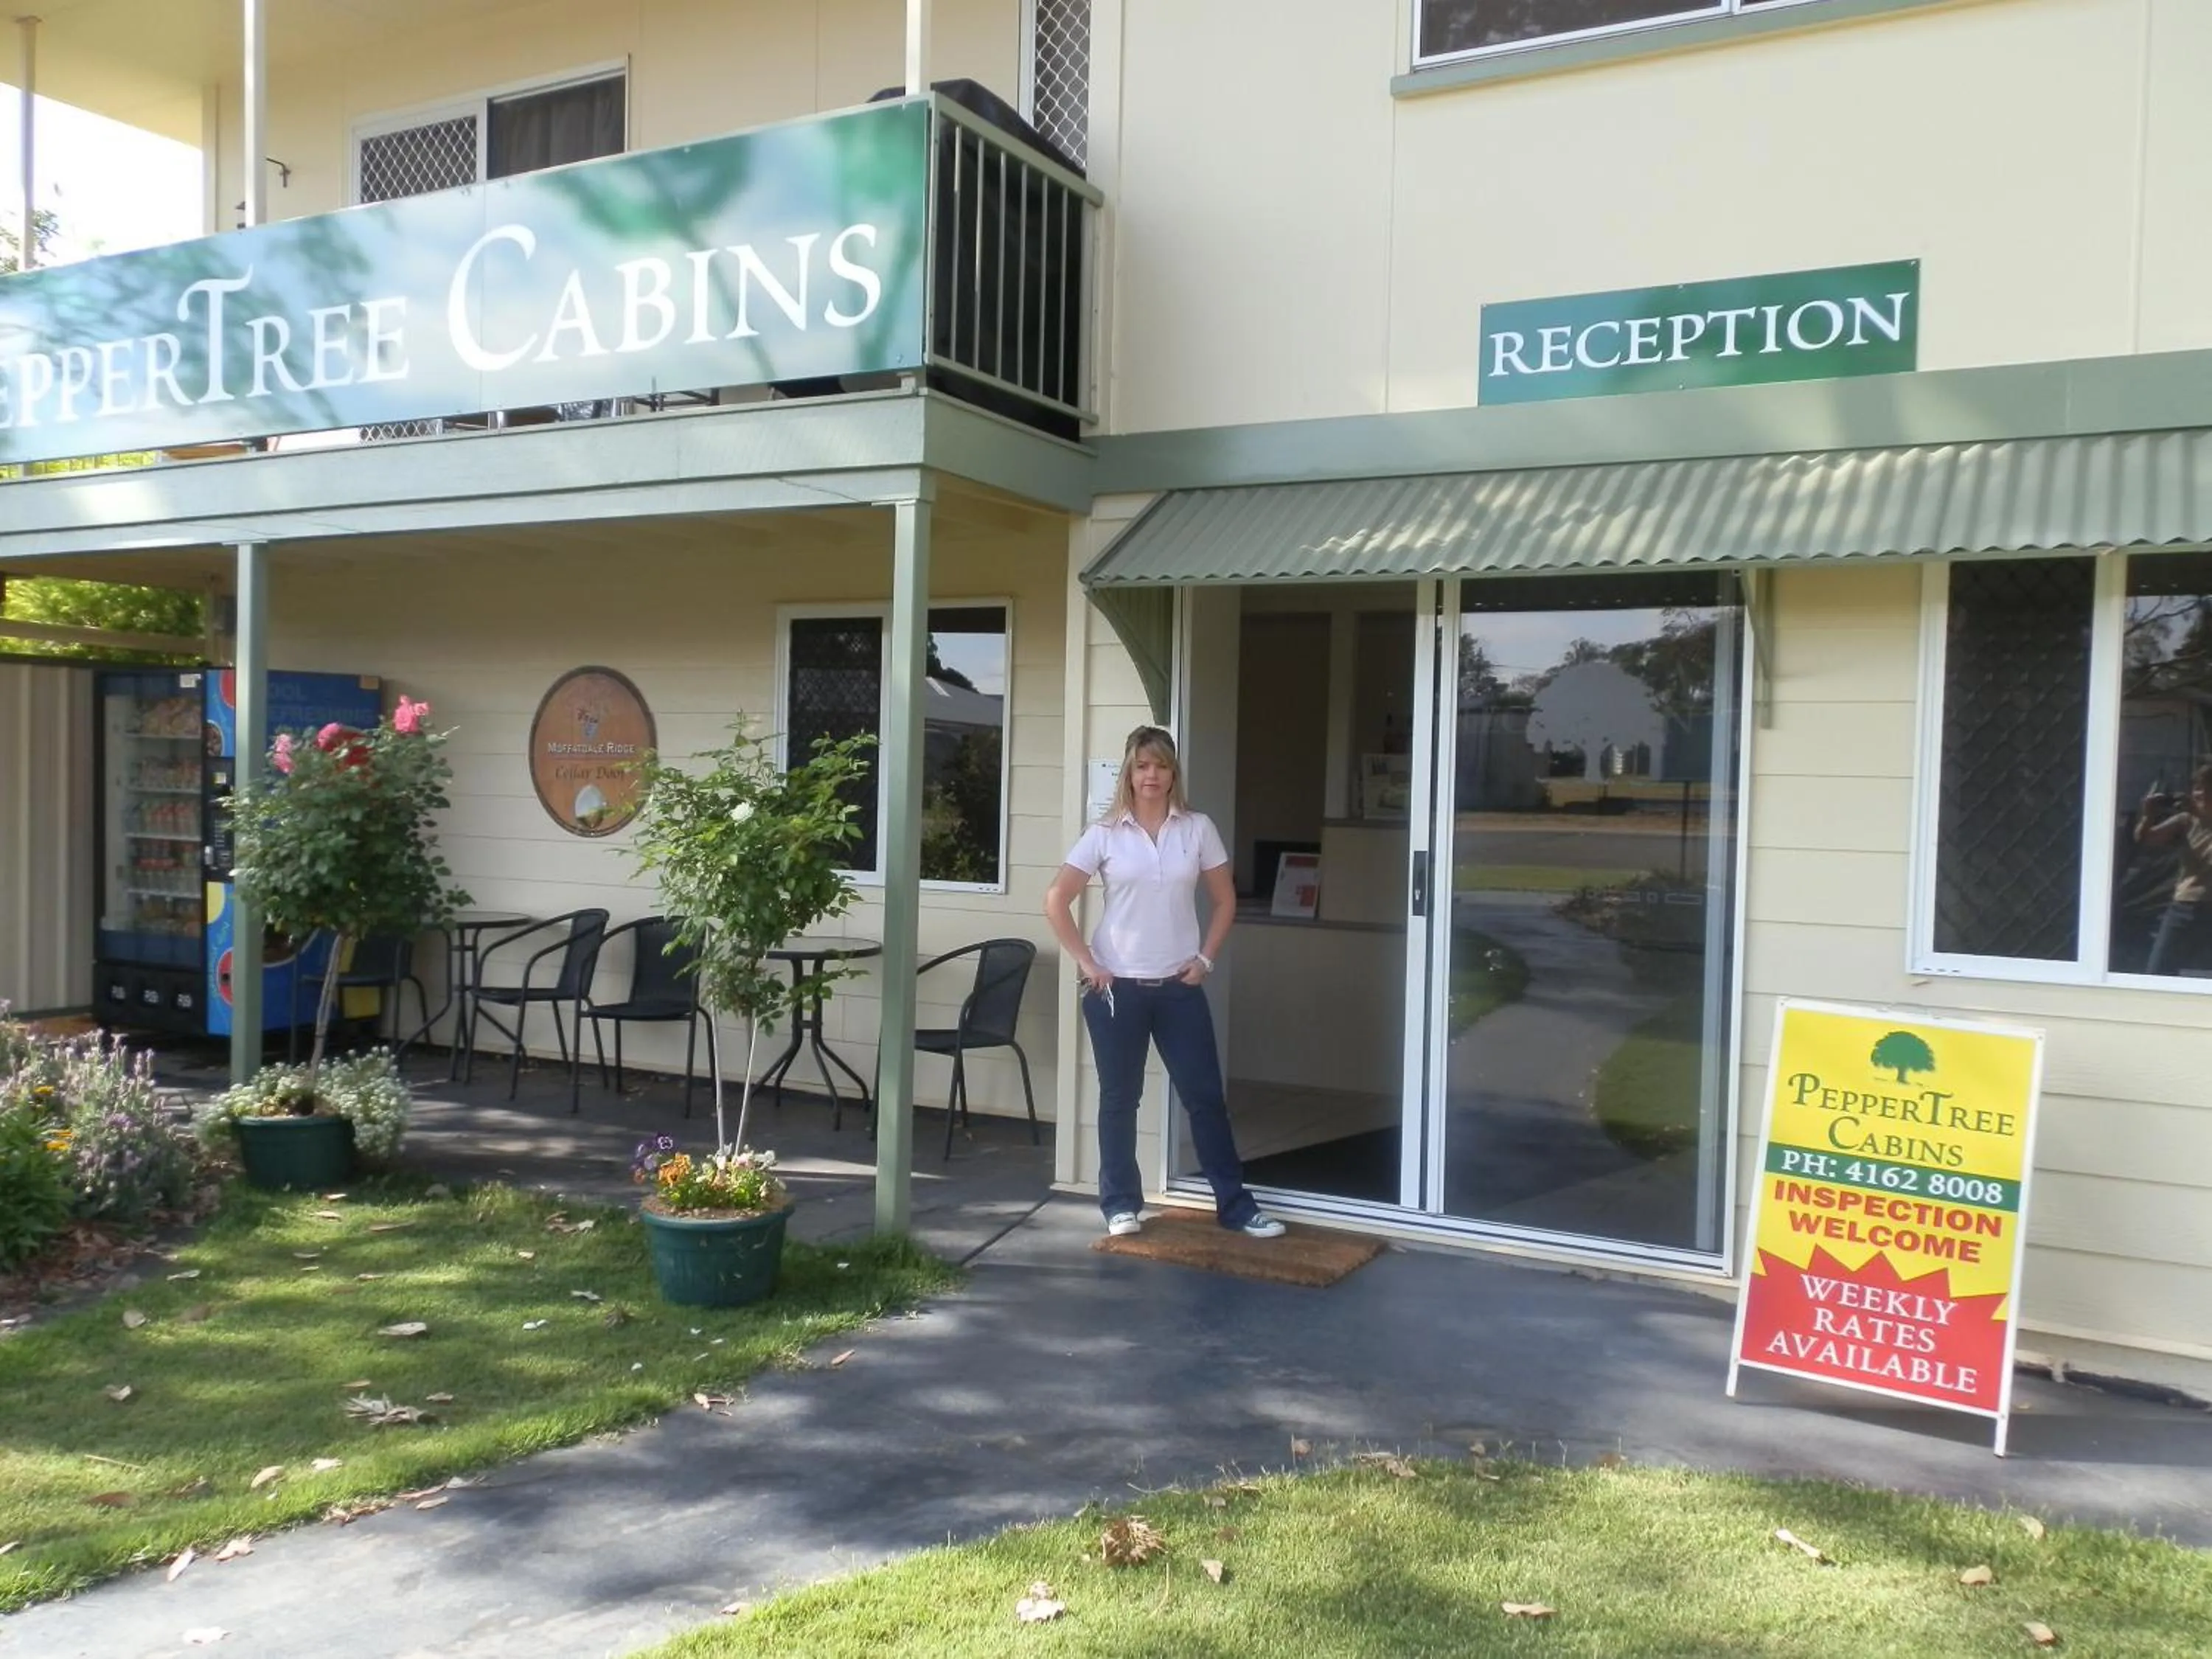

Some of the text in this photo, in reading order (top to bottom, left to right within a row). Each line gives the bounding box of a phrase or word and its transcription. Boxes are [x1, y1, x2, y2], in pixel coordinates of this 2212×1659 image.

[447, 223, 882, 372] CABINS
[1488, 292, 1911, 377] RECEPTION
[1788, 1073, 2016, 1136] PEPPERTREE
[1828, 1116, 1964, 1166] CABINS
[1781, 1150, 2003, 1204] PH: 4162 8008
[1774, 1180, 2003, 1237] INSPECTION
[1789, 1211, 1982, 1263] WELCOME
[1800, 1274, 1958, 1326] WEEKLY
[1813, 1307, 1935, 1354] RATES
[1766, 1330, 1978, 1394] AVAILABLE
